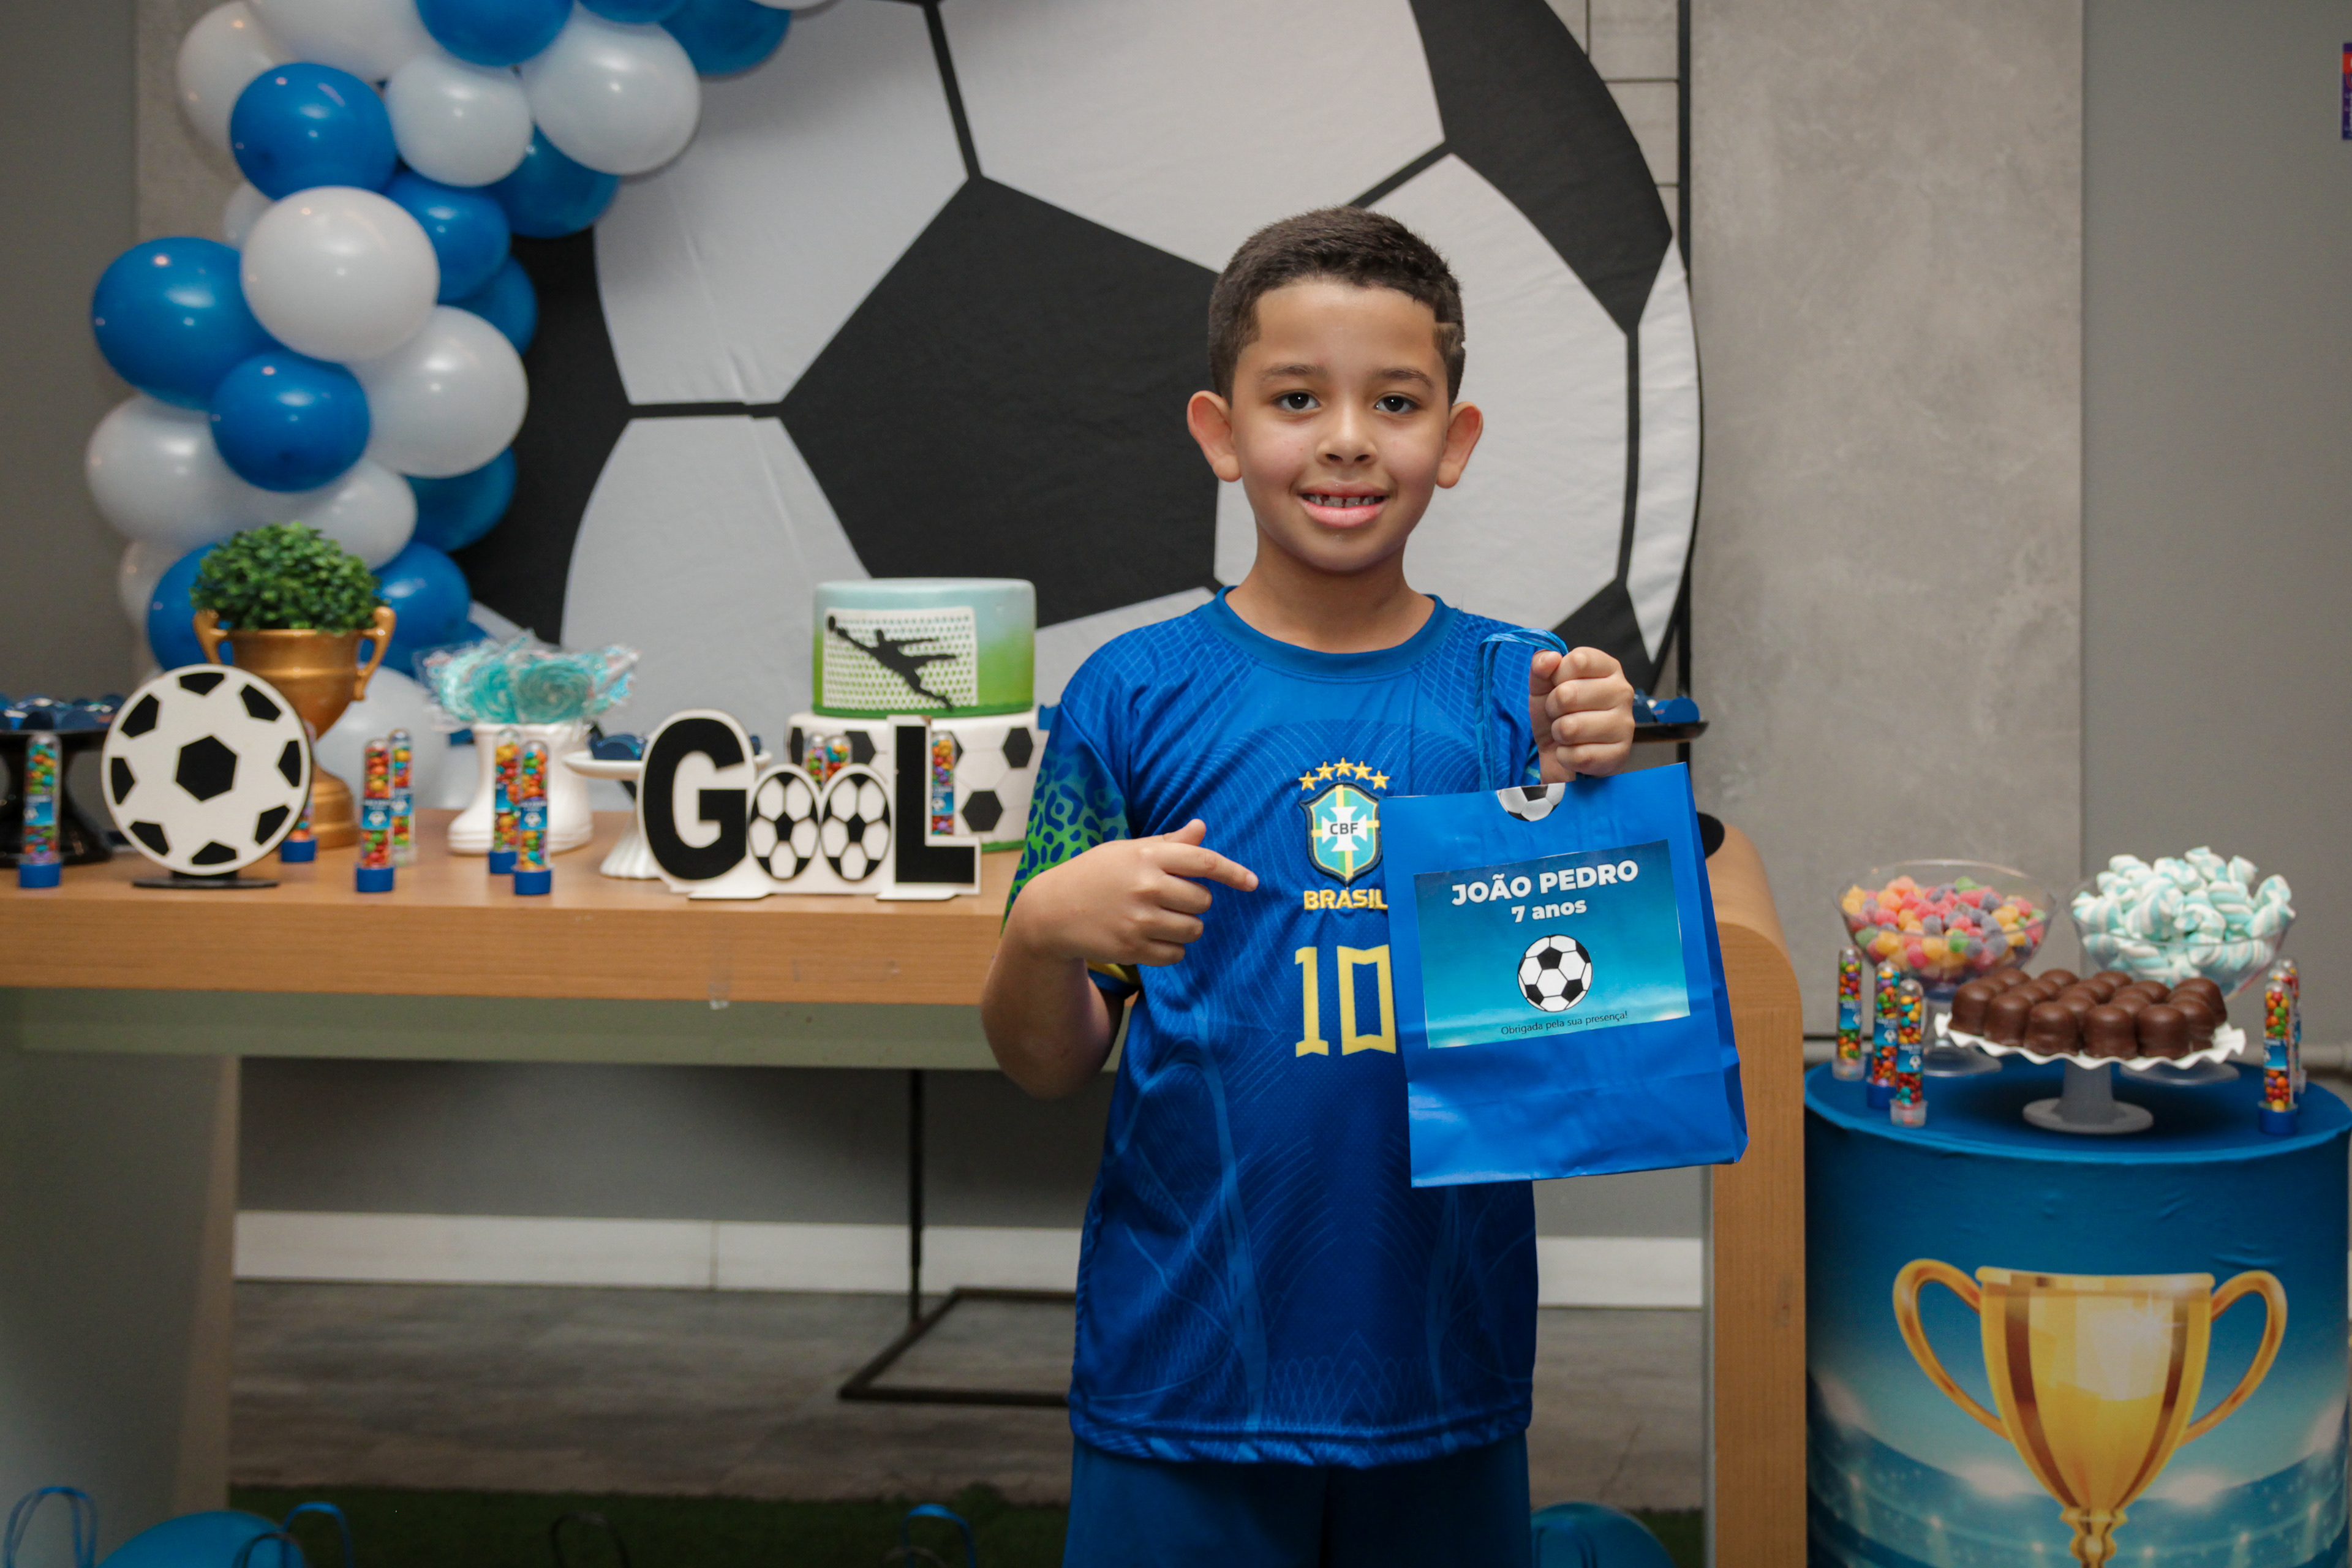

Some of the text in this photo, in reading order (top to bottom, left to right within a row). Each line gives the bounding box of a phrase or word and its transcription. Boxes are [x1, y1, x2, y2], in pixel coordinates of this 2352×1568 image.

[1329, 823, 1359, 835] CBF
[1451, 859, 1639, 906] JOÃO PEDRO
[1303, 889, 1389, 910] BRASIL
[1511, 899, 1588, 923] 7 anos
[1294, 944, 1397, 1058] 10
[1501, 1022, 1542, 1035] Obrigada
[1546, 1019, 1564, 1030] pela
[1585, 1011, 1627, 1025] presença!
